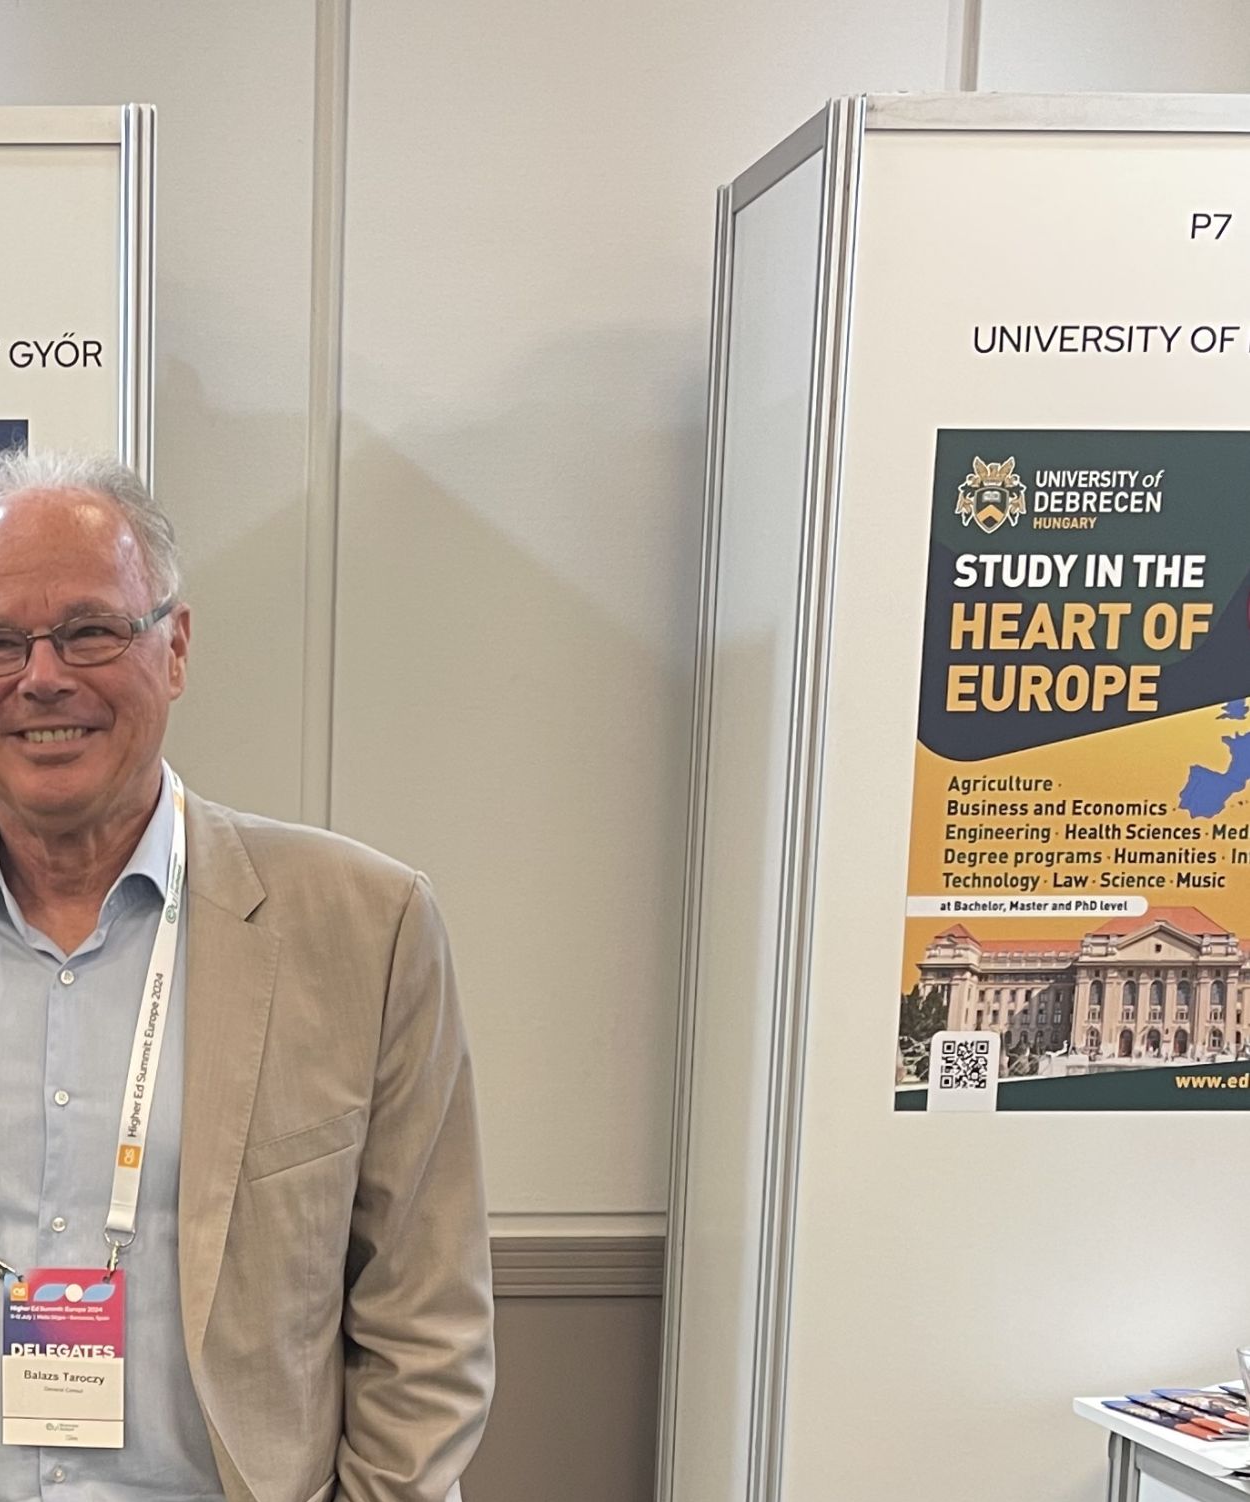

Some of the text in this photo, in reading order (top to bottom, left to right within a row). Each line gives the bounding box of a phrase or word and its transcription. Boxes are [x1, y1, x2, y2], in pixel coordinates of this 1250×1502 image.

[1191, 212, 1233, 240] P7
[973, 325, 1182, 354] UNIVERSITY
[1190, 325, 1240, 353] OF
[8, 332, 103, 369] GYŐR
[1035, 469, 1165, 488] UNIVERSITY of
[1033, 491, 1163, 513] DEBRECEN
[1033, 517, 1097, 530] HUNGARY
[953, 554, 1206, 588] STUDY IN THE
[950, 602, 1214, 651] HEART OF
[946, 664, 1162, 712] EUROPE
[948, 775, 1053, 795] Agriculture
[947, 800, 1168, 817] Business and Economics
[945, 824, 1051, 843] Engineering
[1065, 824, 1121, 840] Health
[1125, 824, 1201, 840] Sciences
[944, 848, 1009, 867] Degree
[1014, 851, 1102, 868] programs
[1114, 848, 1217, 864] Humanities
[942, 872, 1226, 892] Technology Law Science Music
[940, 901, 1128, 913] at Bachelor, Master and PhD level
[127, 972, 164, 1138] Higher Ed Summit Europe 2024
[10, 1343, 115, 1359] DELEGATES
[24, 1369, 105, 1386] Balazs Taroczy
